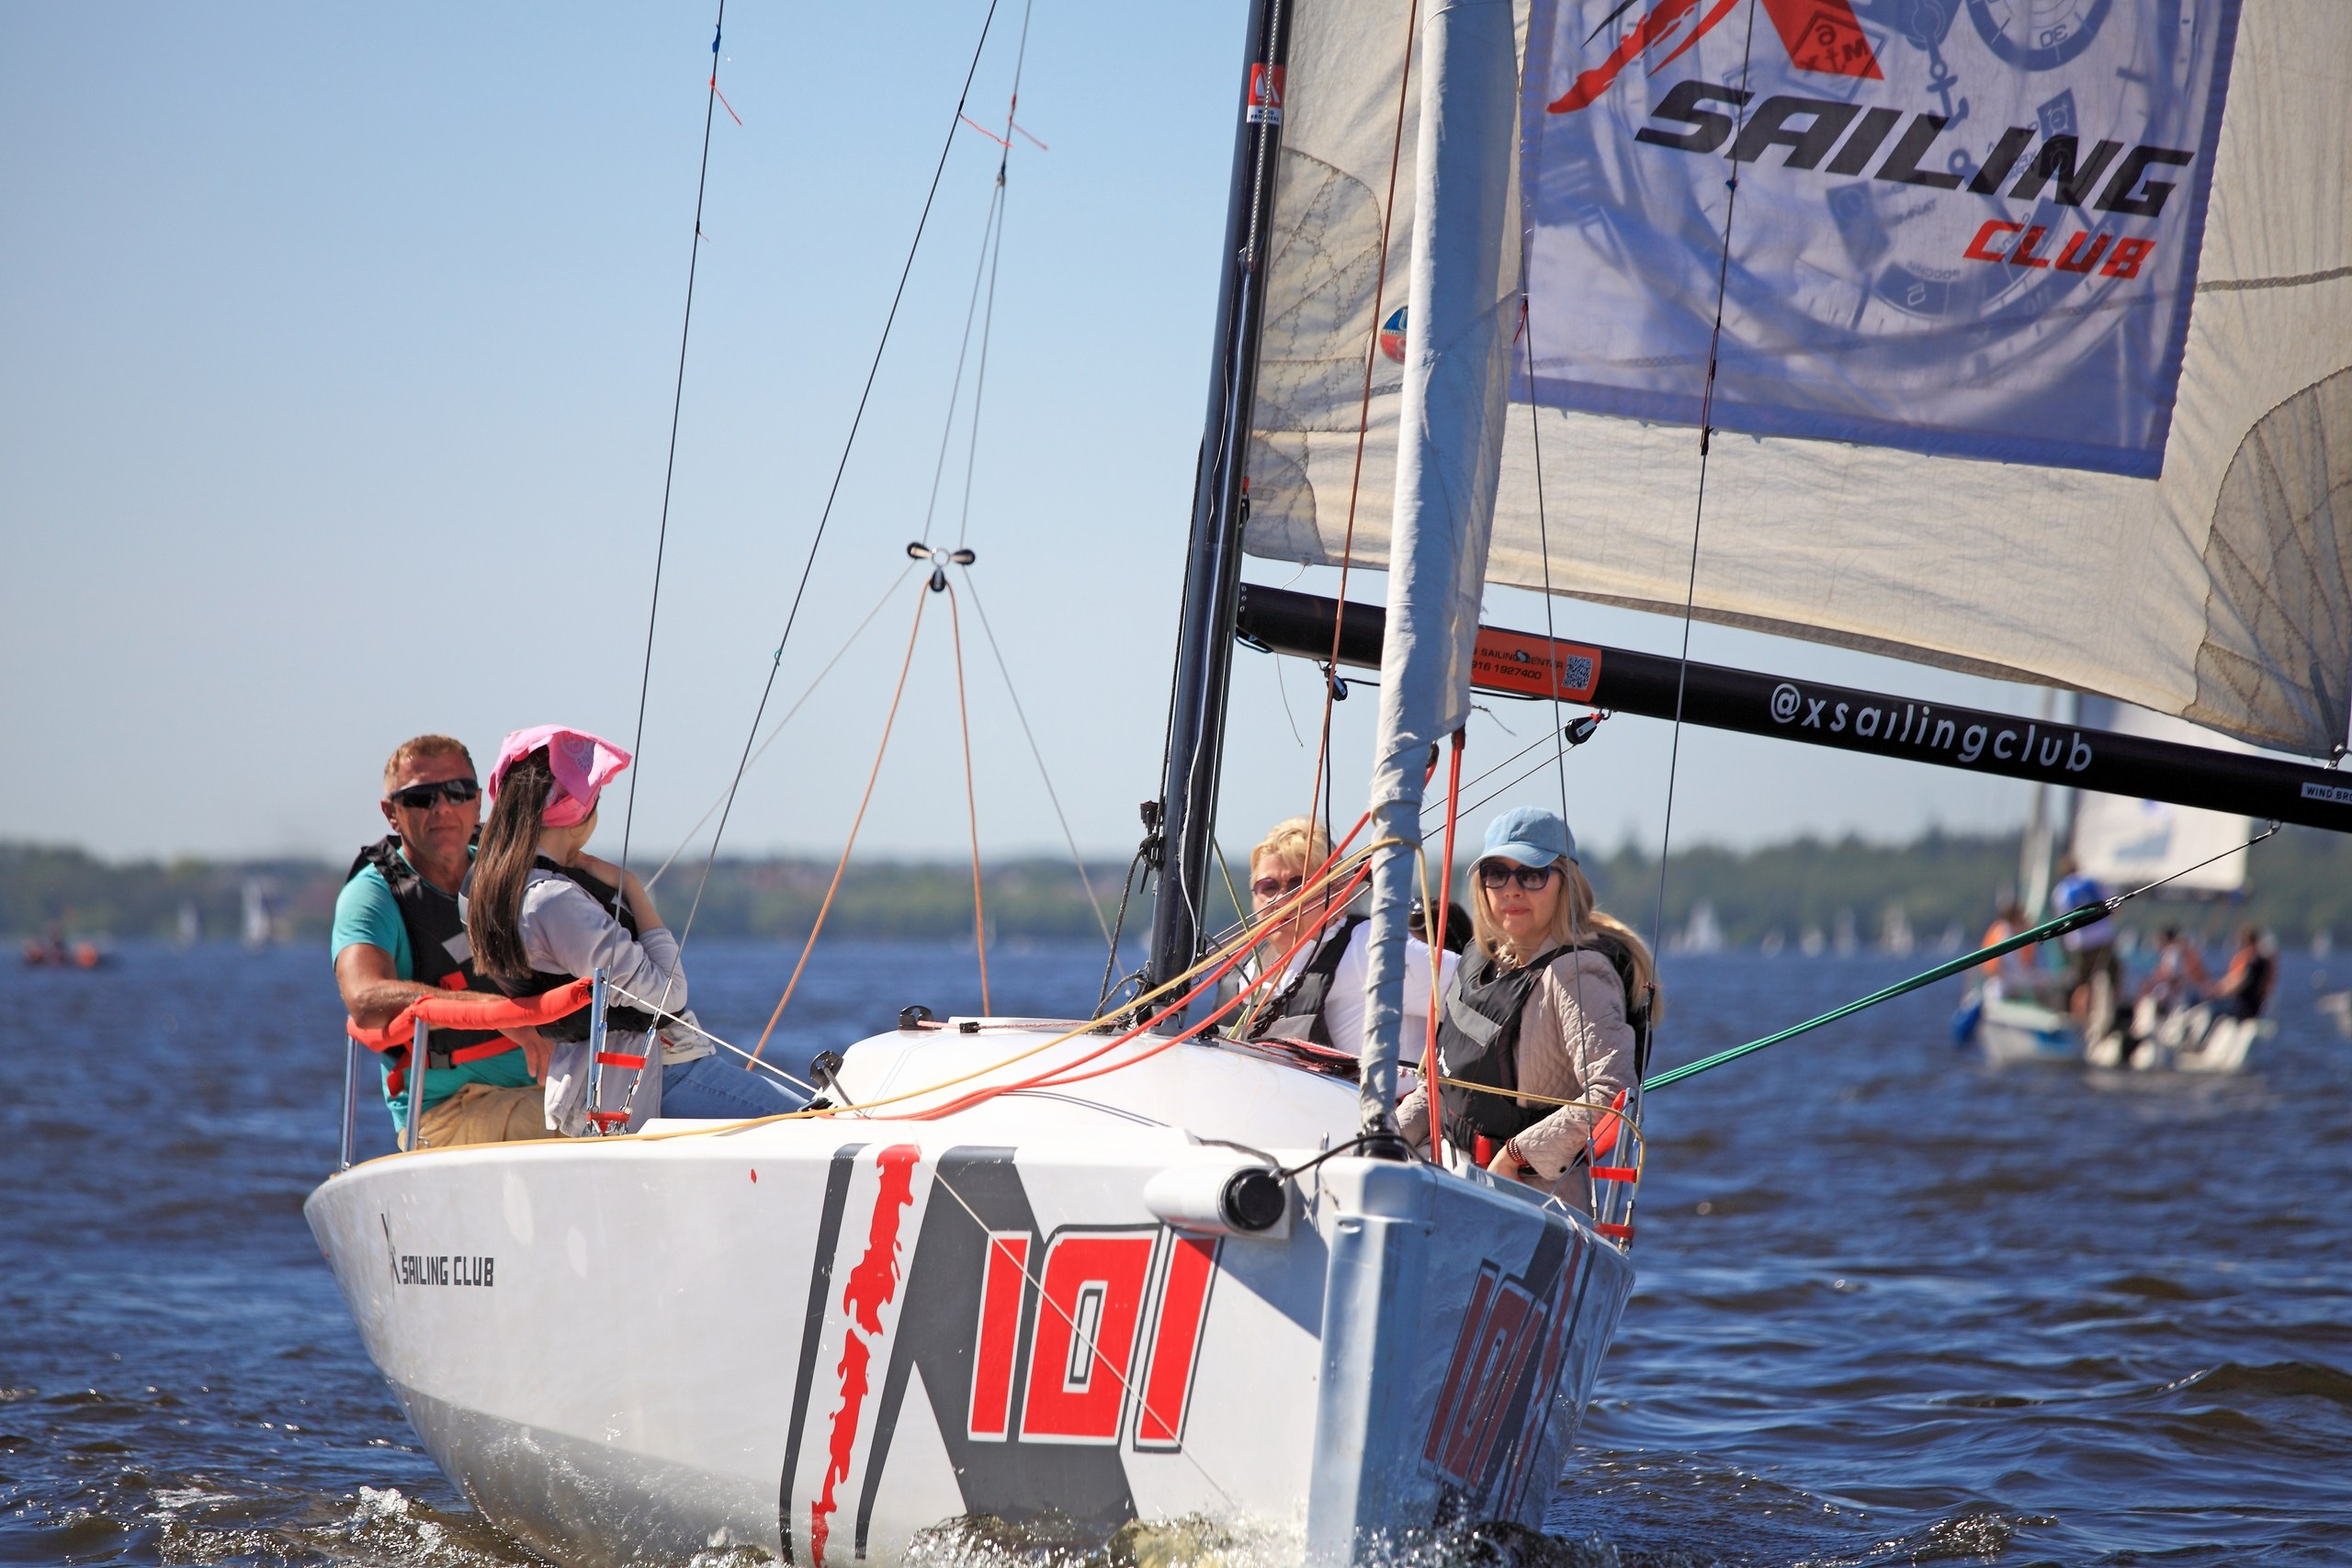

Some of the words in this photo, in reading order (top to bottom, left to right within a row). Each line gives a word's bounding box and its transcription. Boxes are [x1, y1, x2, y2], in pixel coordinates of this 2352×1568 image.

[1250, 114, 1280, 122] BROERS
[1634, 81, 2194, 218] SAILING
[1962, 220, 2156, 279] CLUB
[1495, 663, 1543, 680] 1927400
[1521, 654, 1564, 670] ENTR
[1770, 682, 2093, 773] @xsailingclub
[2306, 785, 2333, 798] WIND
[401, 1255, 448, 1286] SAILING
[454, 1256, 494, 1287] CLUB
